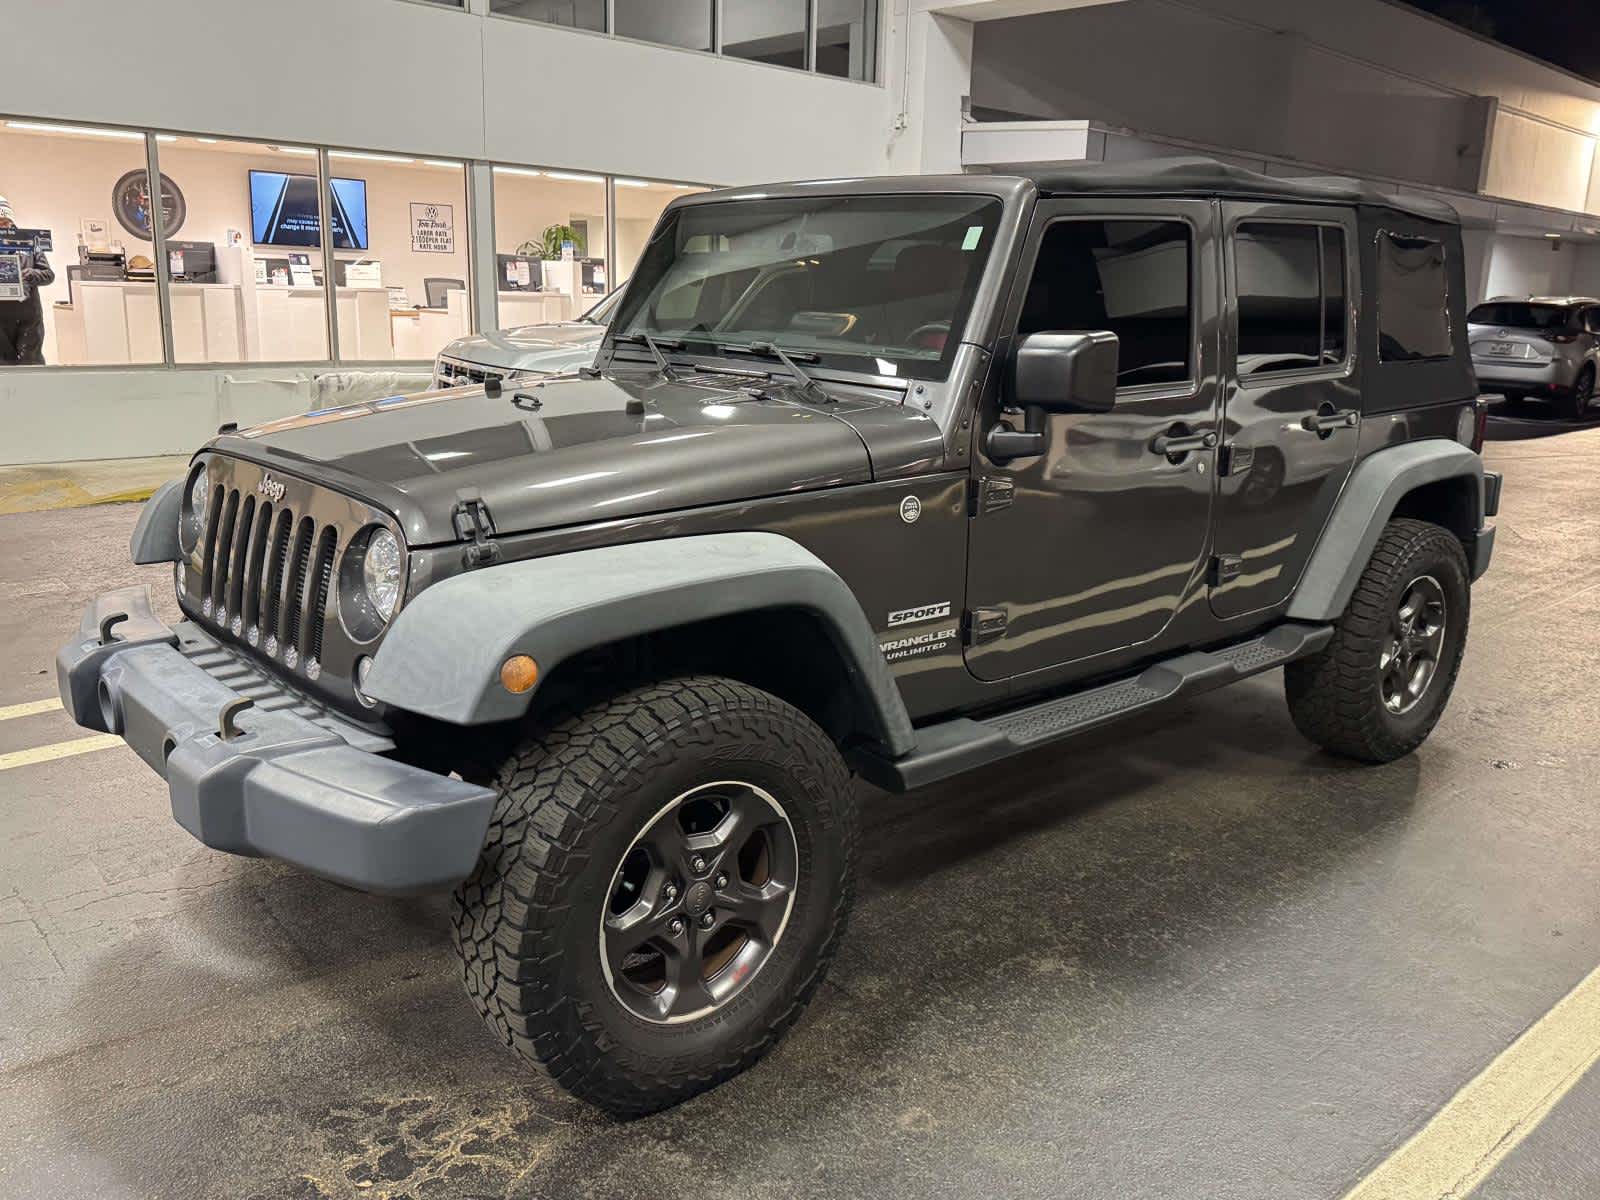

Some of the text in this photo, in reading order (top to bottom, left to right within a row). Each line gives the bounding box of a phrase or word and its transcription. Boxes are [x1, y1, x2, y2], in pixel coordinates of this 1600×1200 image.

[256, 472, 286, 504] Jeep
[891, 606, 946, 622] SPORT
[887, 642, 947, 660] UNLIMITED
